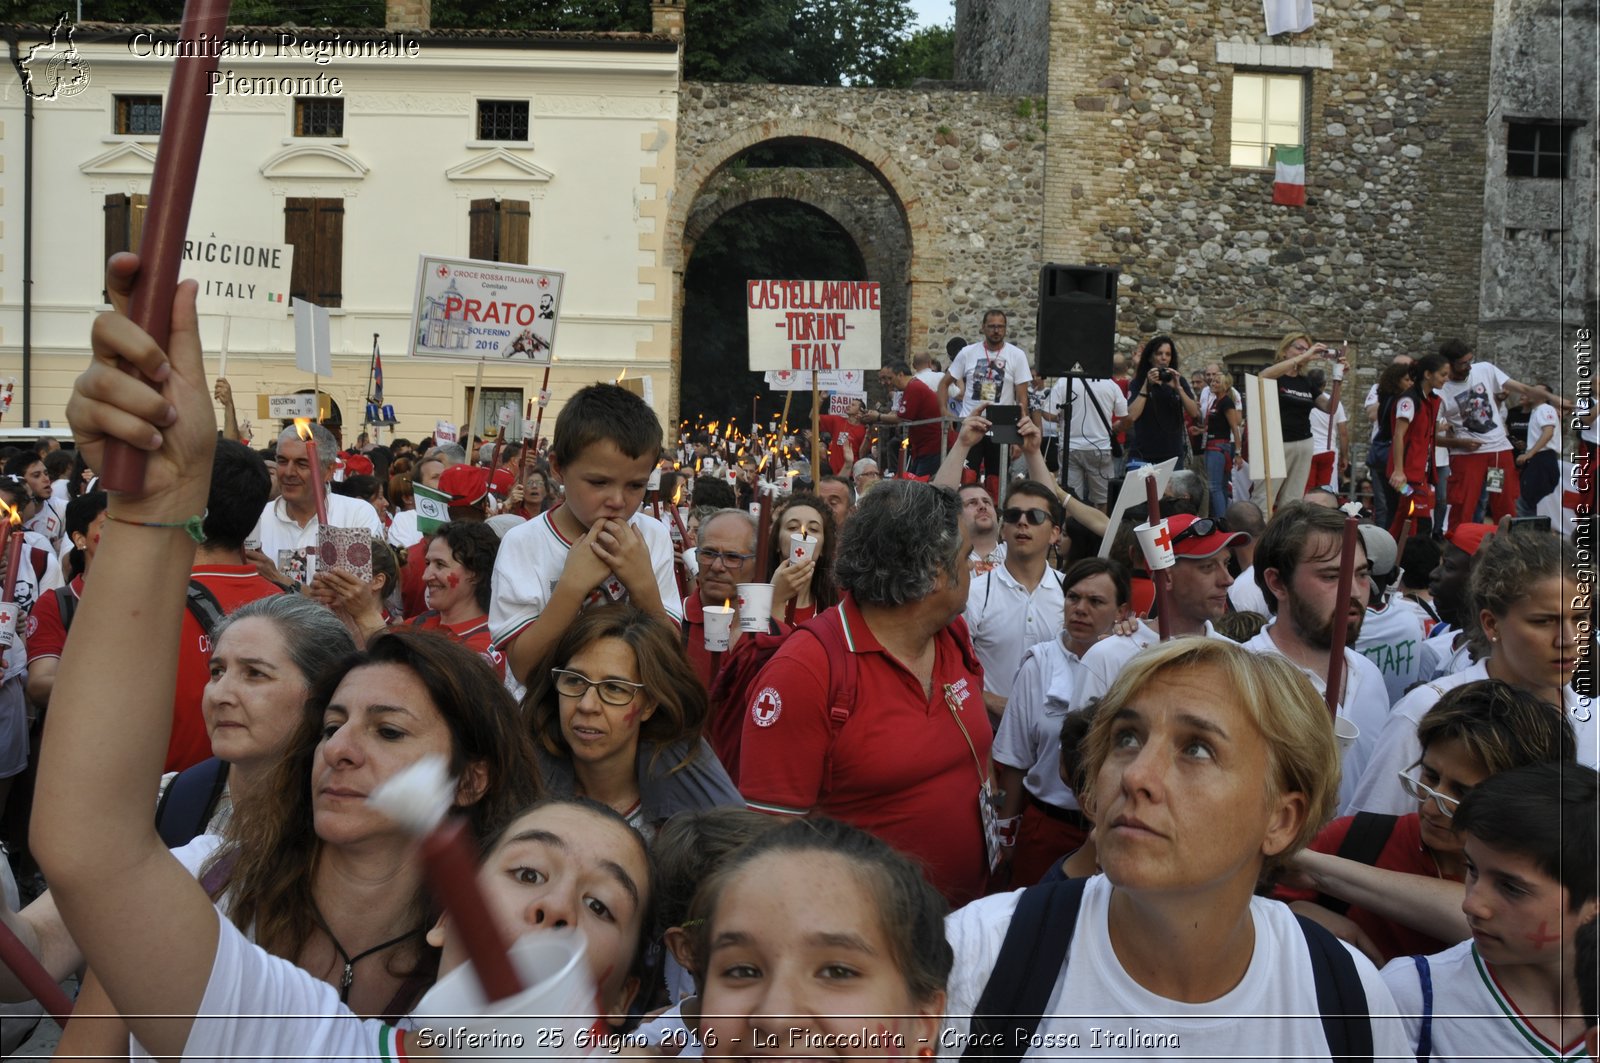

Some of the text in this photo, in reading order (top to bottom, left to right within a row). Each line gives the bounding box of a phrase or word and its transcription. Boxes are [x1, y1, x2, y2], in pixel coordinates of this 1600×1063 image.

[182, 240, 282, 269] RICCIONE
[454, 270, 534, 285] CROCE ROSSA ITALIANA
[206, 280, 256, 300] ITALY
[481, 282, 508, 291] Comitato
[748, 280, 881, 310] CASTELLAMONTE
[444, 297, 535, 327] PRATO
[467, 327, 511, 337] SOLFERINO
[475, 340, 499, 351] 2016
